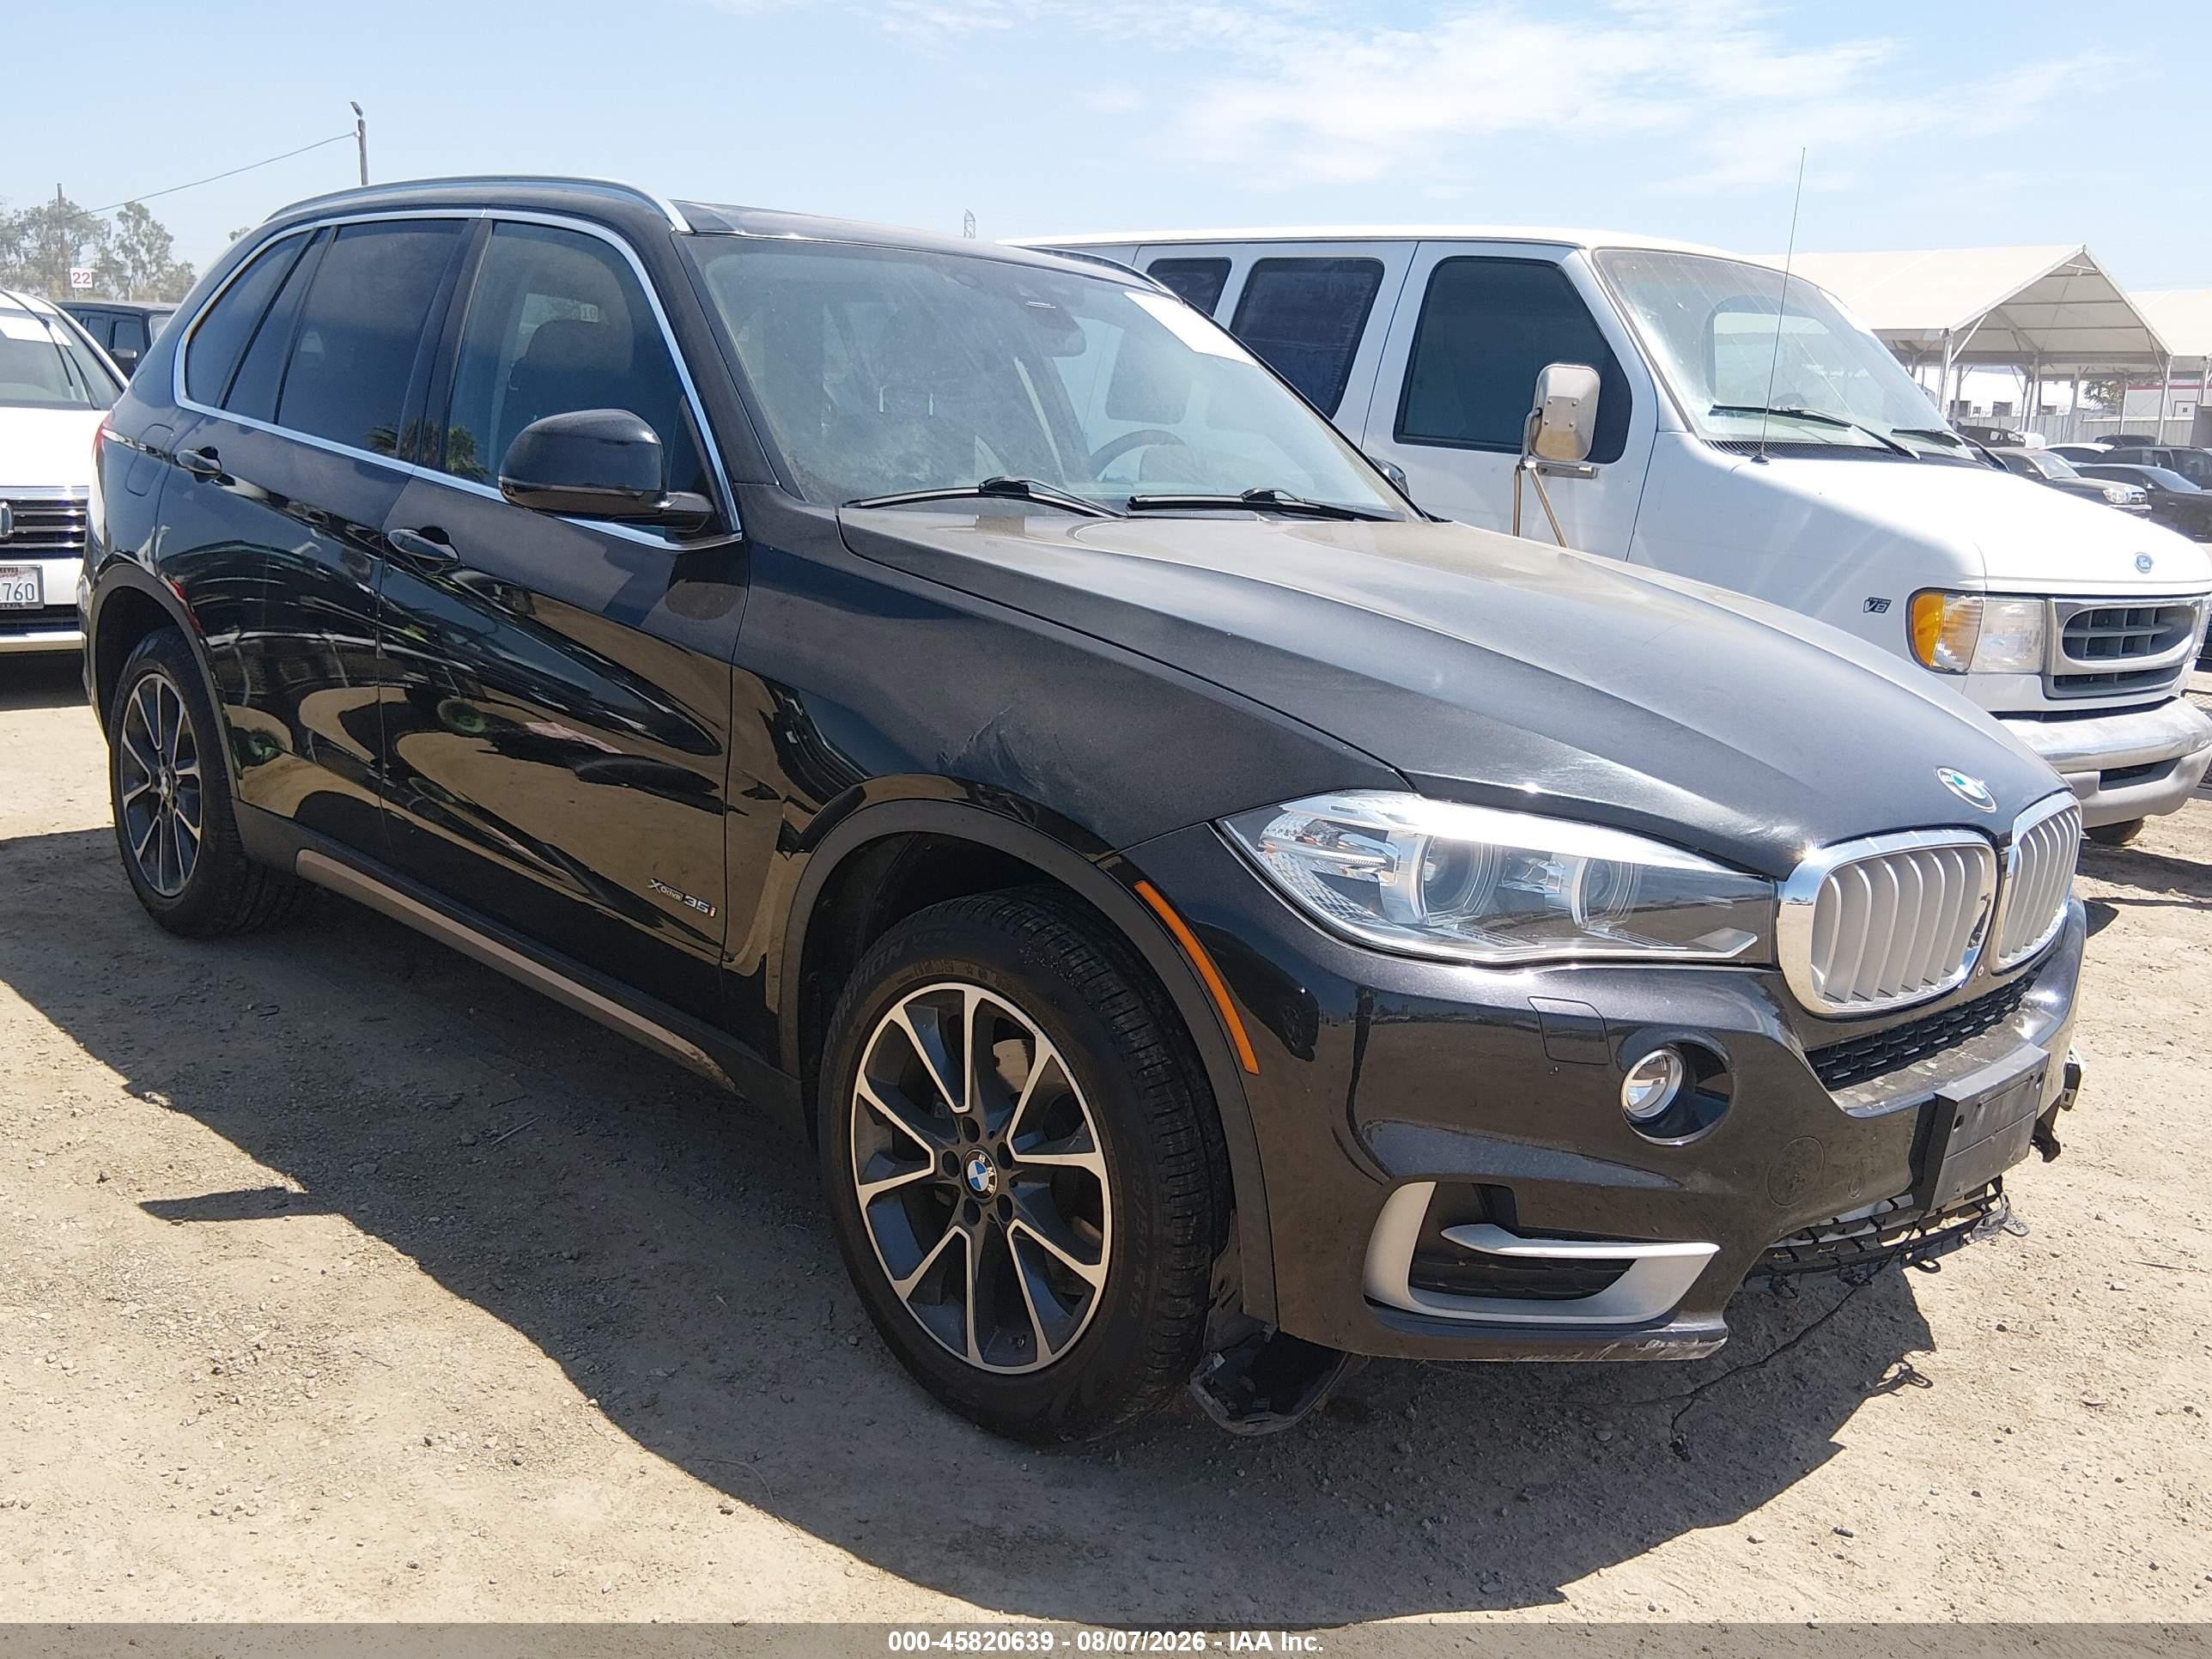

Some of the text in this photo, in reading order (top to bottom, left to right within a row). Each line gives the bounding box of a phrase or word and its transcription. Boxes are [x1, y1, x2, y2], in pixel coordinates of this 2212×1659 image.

[73, 272, 91, 284] 22
[0, 582, 34, 601] 760
[1864, 600, 1887, 612] V8
[977, 1153, 996, 1194] BMW
